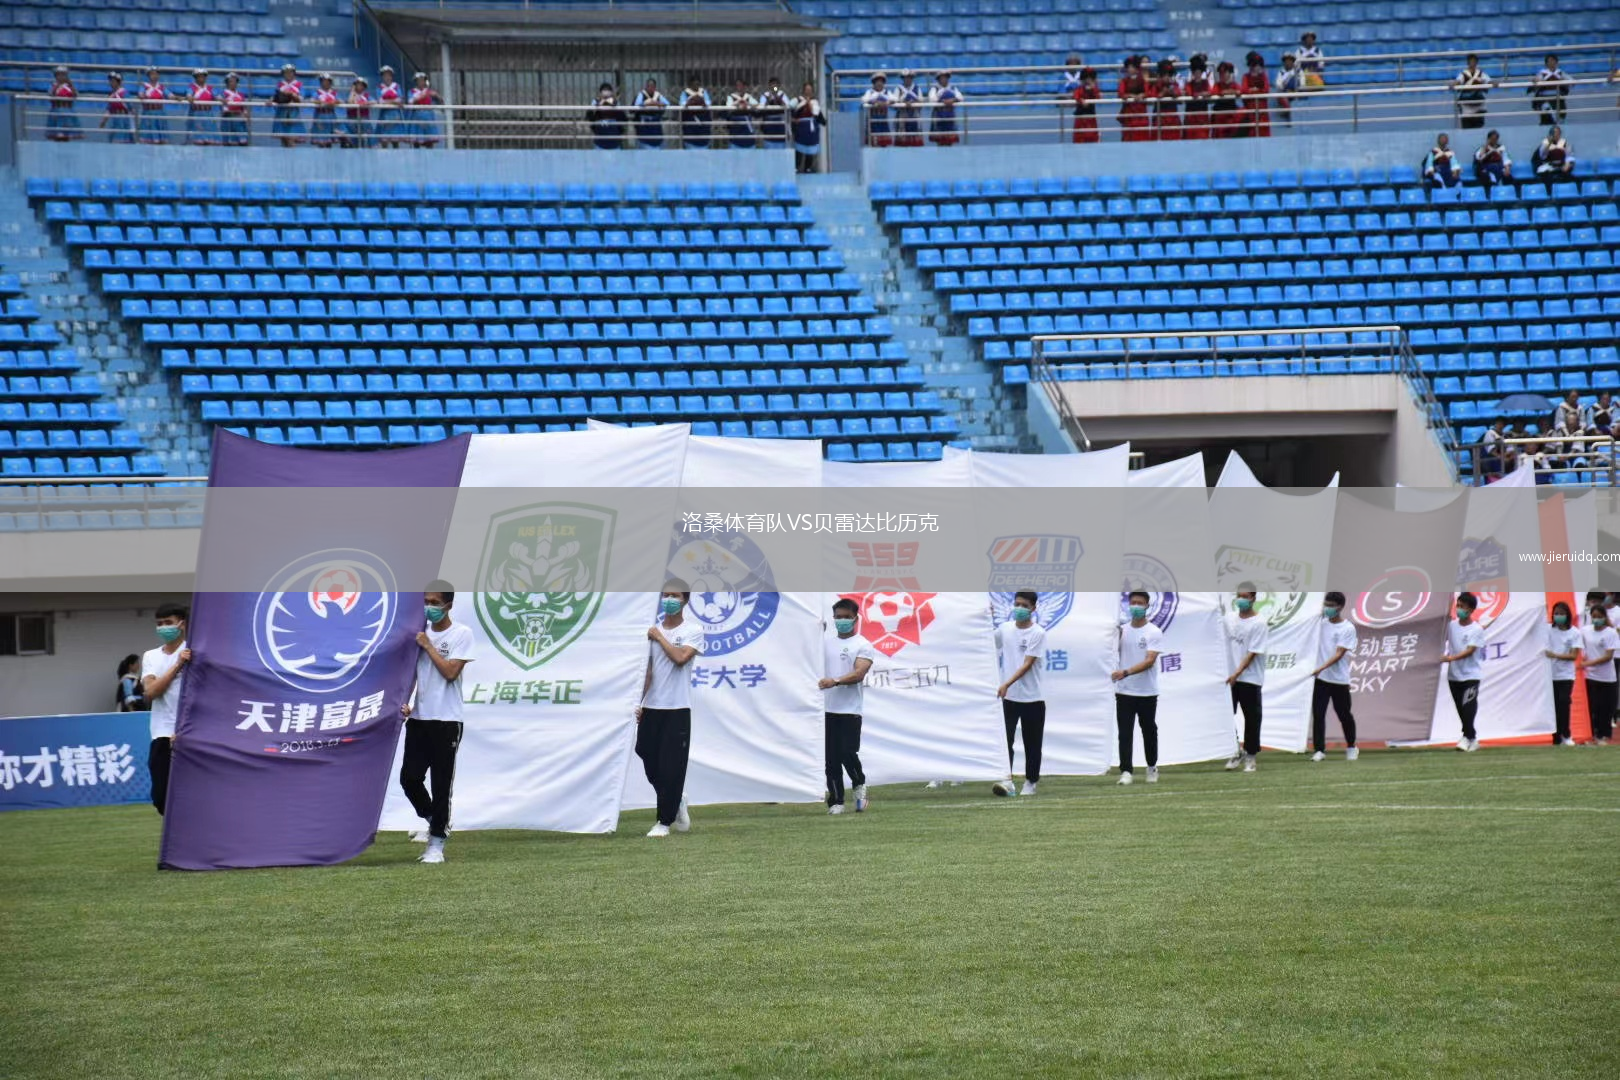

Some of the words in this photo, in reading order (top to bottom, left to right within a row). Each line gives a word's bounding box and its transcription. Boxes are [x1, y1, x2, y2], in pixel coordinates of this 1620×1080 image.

[518, 526, 535, 538] IUS
[553, 525, 576, 537] LEX
[847, 541, 920, 567] 359
[1266, 558, 1302, 573] CLUB
[993, 575, 1068, 586] DEEHERO
[1351, 633, 1419, 658] 动星空
[1160, 652, 1181, 673] 唐
[463, 680, 583, 705] 上海华正
[1349, 675, 1392, 694] SKY
[235, 690, 385, 733] 天津富晟
[0, 743, 136, 791] 你才精彩
